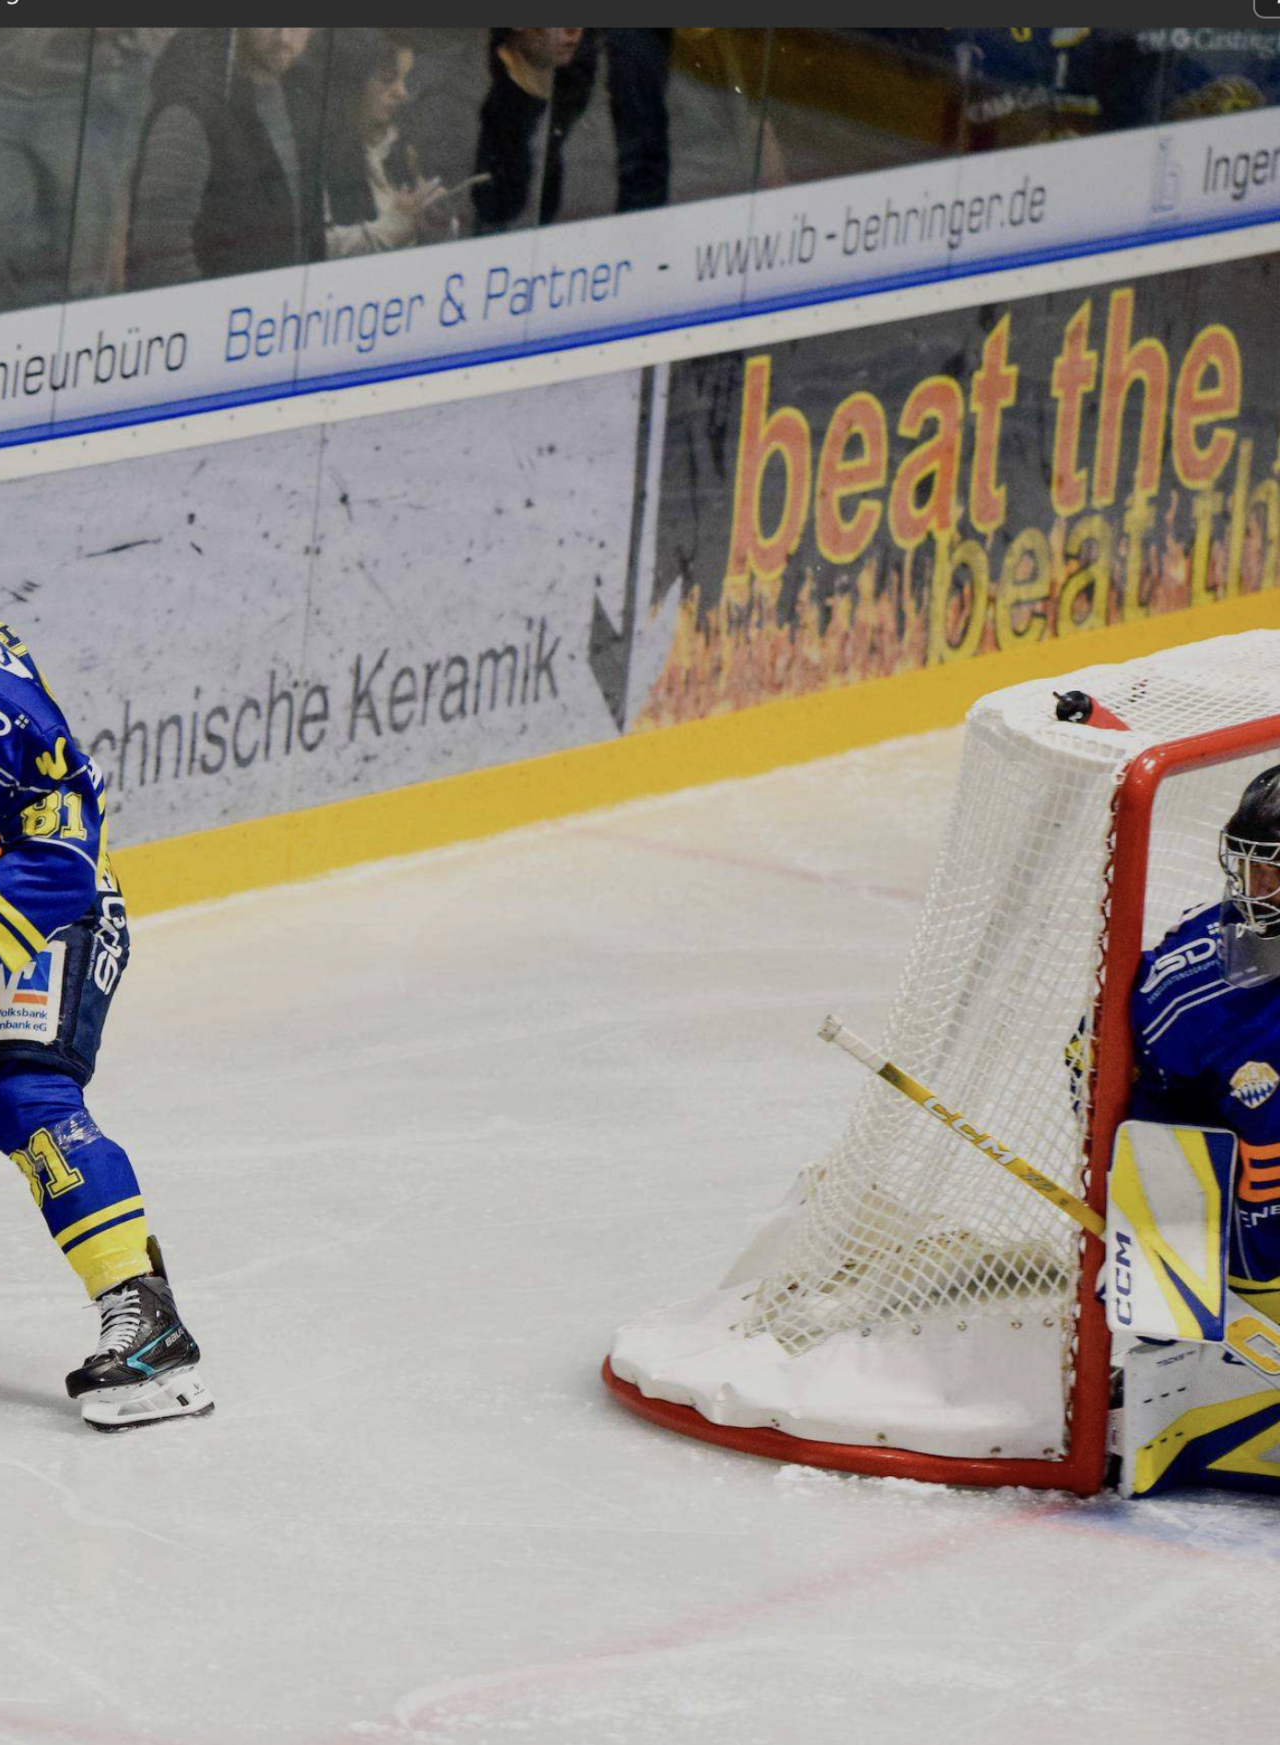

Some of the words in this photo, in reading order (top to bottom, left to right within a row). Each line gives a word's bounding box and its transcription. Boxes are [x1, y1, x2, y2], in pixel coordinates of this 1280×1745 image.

[224, 293, 424, 363] Behringer
[438, 273, 468, 328] &
[483, 259, 631, 320] Partner
[727, 313, 1017, 585] beat
[1051, 288, 1242, 516] the
[927, 490, 1157, 664] beat
[348, 617, 563, 743] Keramik
[21, 789, 88, 842] 81
[923, 1095, 1020, 1167] CCM
[1115, 1230, 1132, 1327] CCM
